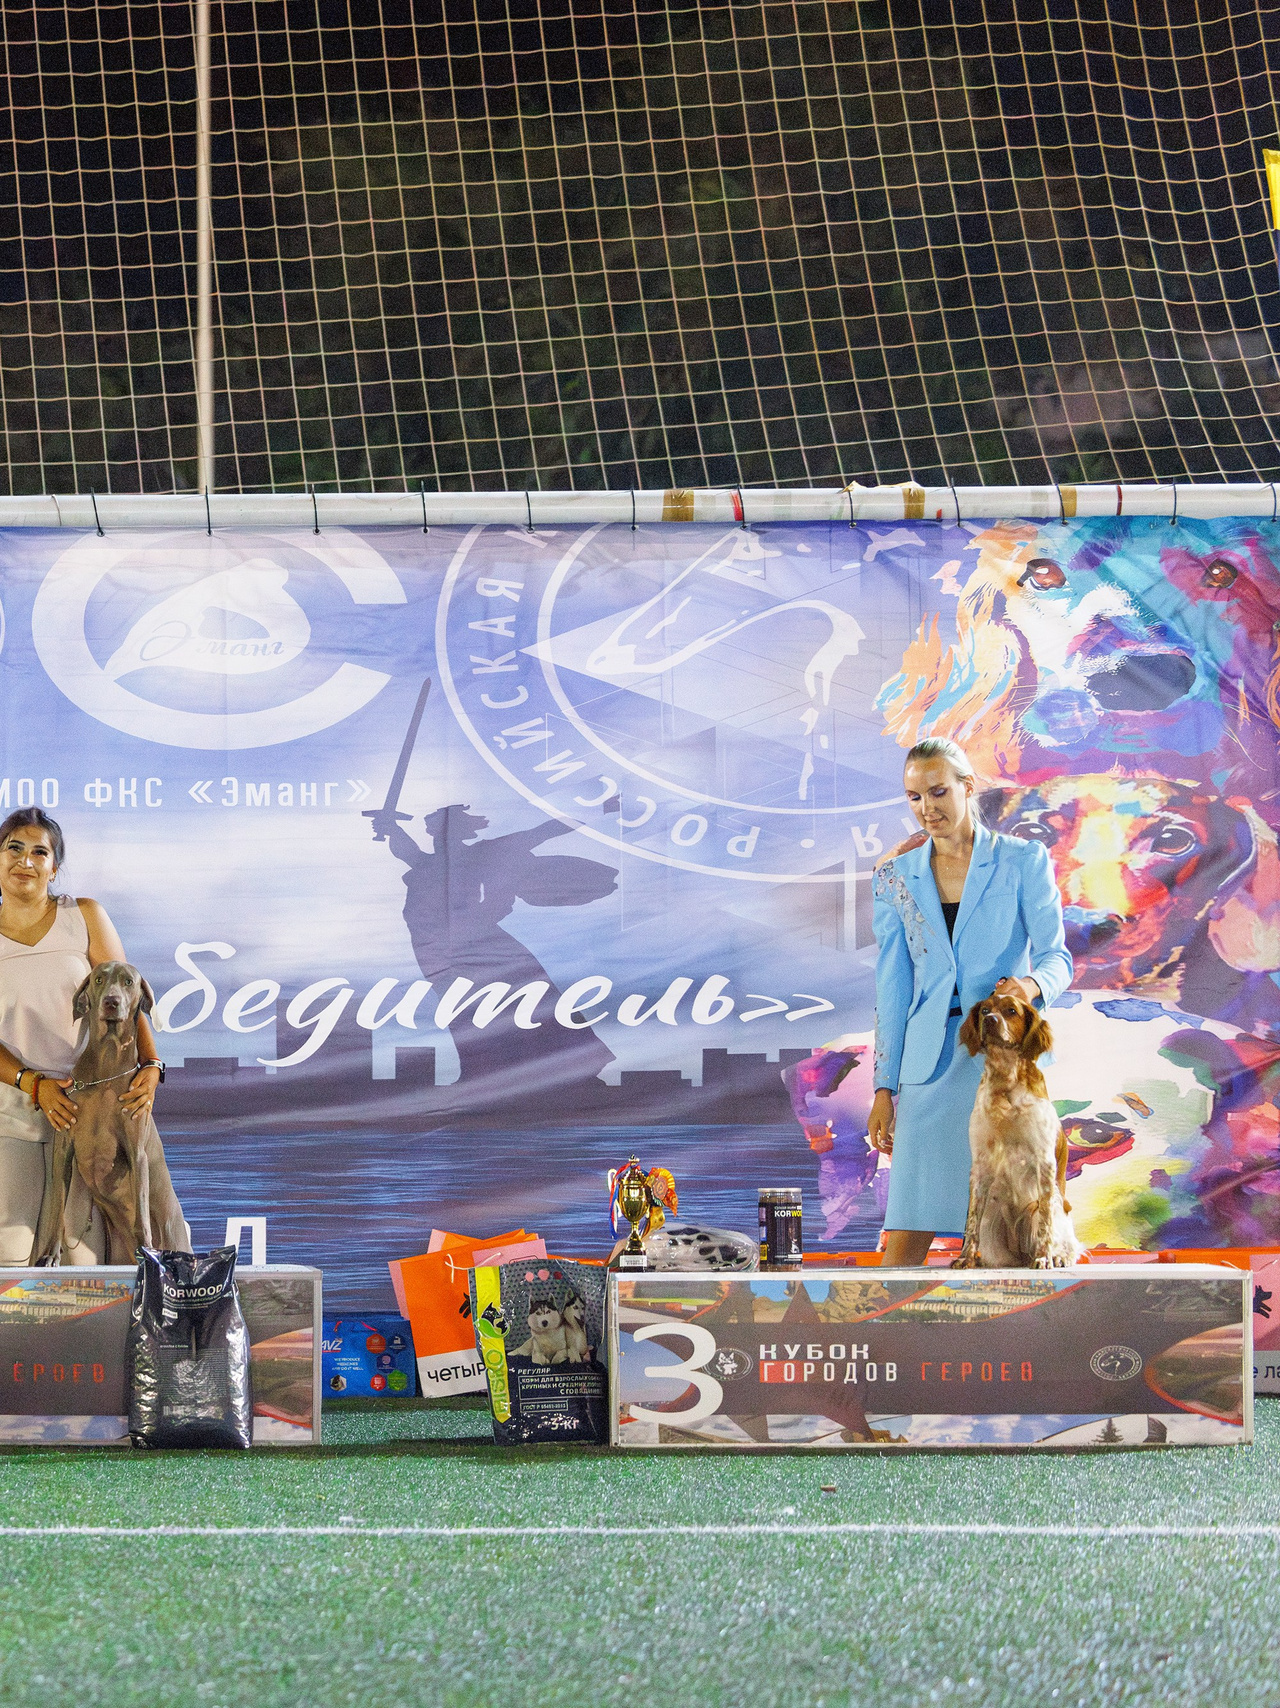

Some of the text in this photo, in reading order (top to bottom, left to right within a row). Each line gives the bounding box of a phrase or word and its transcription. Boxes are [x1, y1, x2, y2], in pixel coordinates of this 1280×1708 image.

[83, 777, 163, 807] ФКС
[187, 777, 373, 807] «Эманг»
[163, 1283, 223, 1298] KORWOOD
[760, 1344, 870, 1361] КУБОК
[427, 1362, 487, 1383] четыр
[518, 1367, 551, 1375] РЕГУЛЯР
[629, 1322, 724, 1425] 3
[764, 1362, 898, 1384] ГОРОДОВ
[921, 1362, 1033, 1381] ГЕРОЕВ
